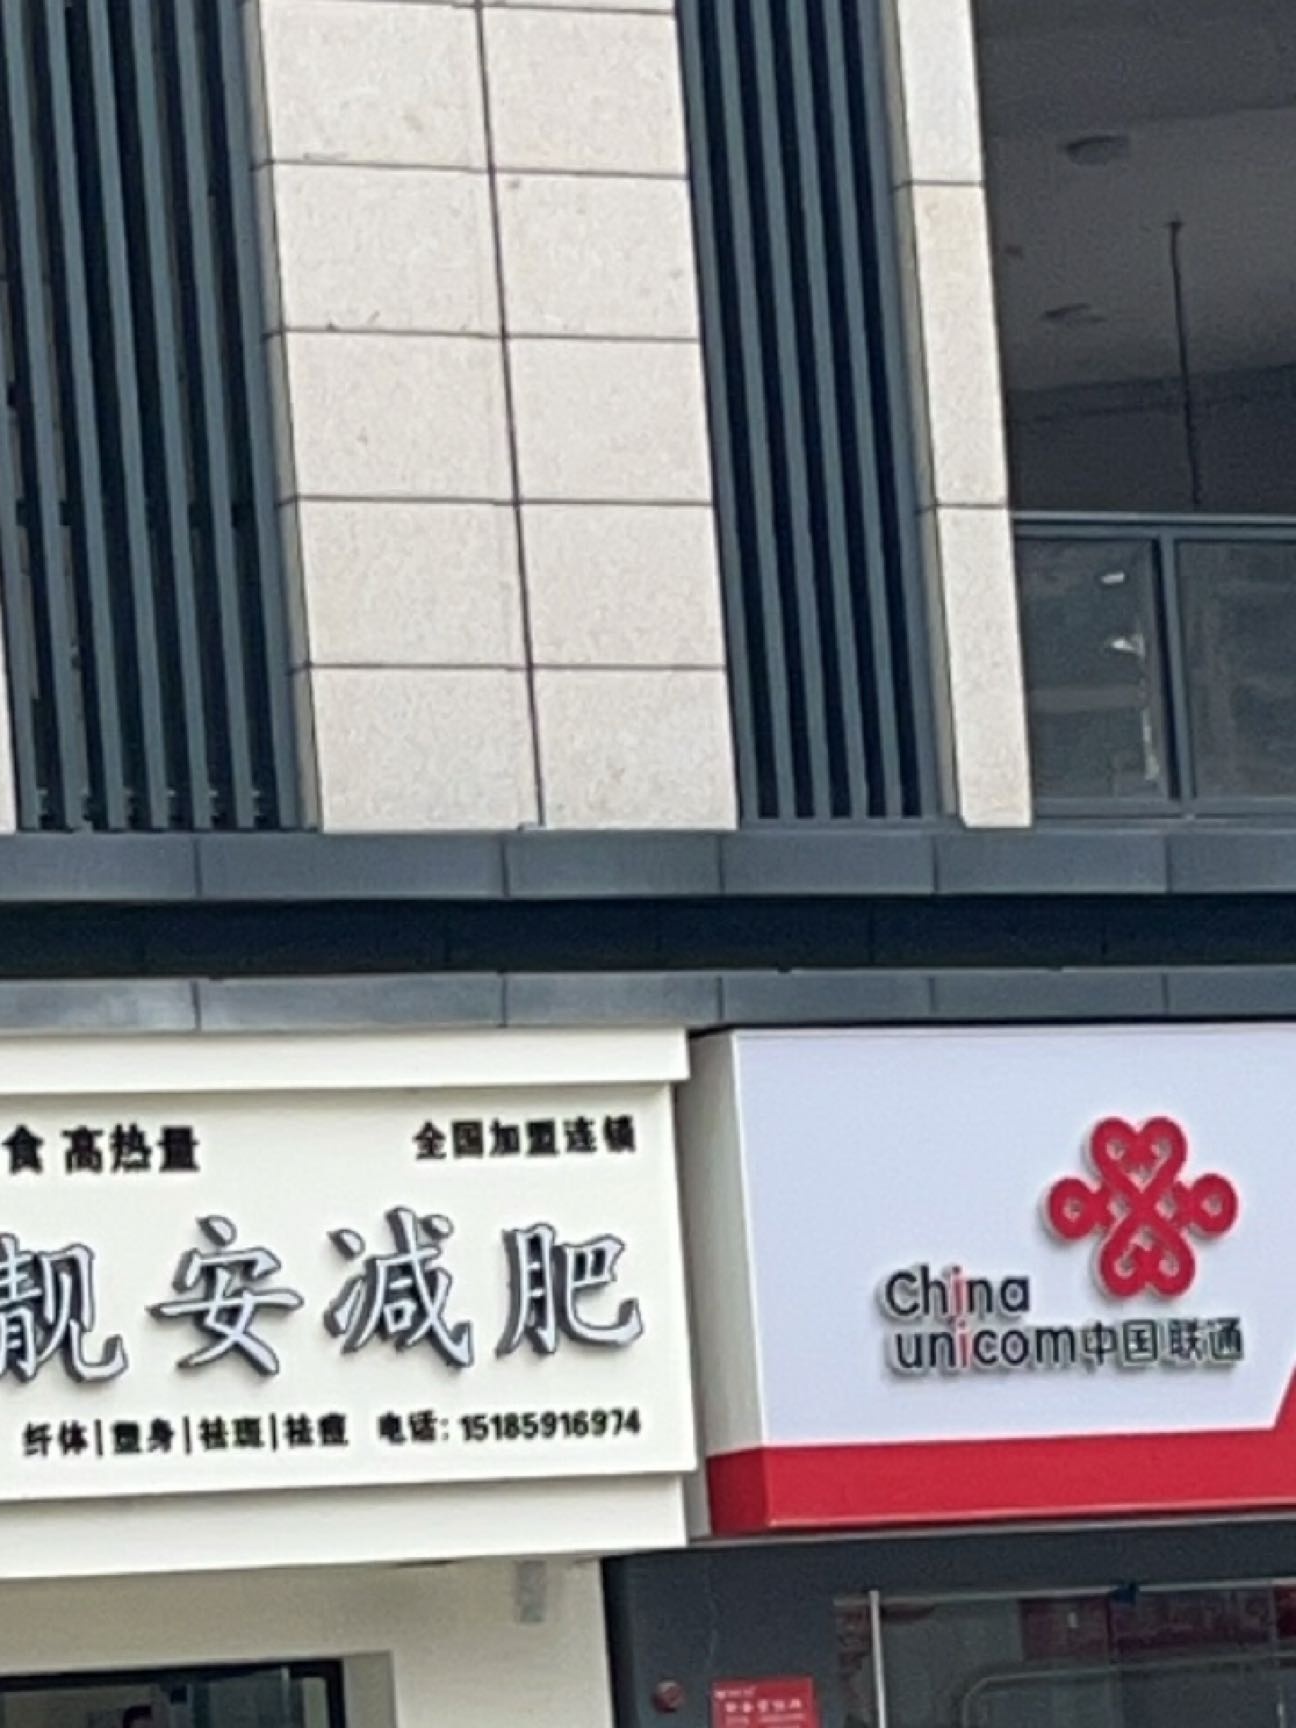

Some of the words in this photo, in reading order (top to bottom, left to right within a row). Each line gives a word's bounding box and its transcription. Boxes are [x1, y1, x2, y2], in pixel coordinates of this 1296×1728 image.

[61, 1122, 201, 1174] 高热量
[412, 1115, 636, 1160] 全国加盟连锁
[885, 1263, 1030, 1317] China
[896, 1318, 1077, 1369] unicom
[1082, 1317, 1245, 1368] 中国联通
